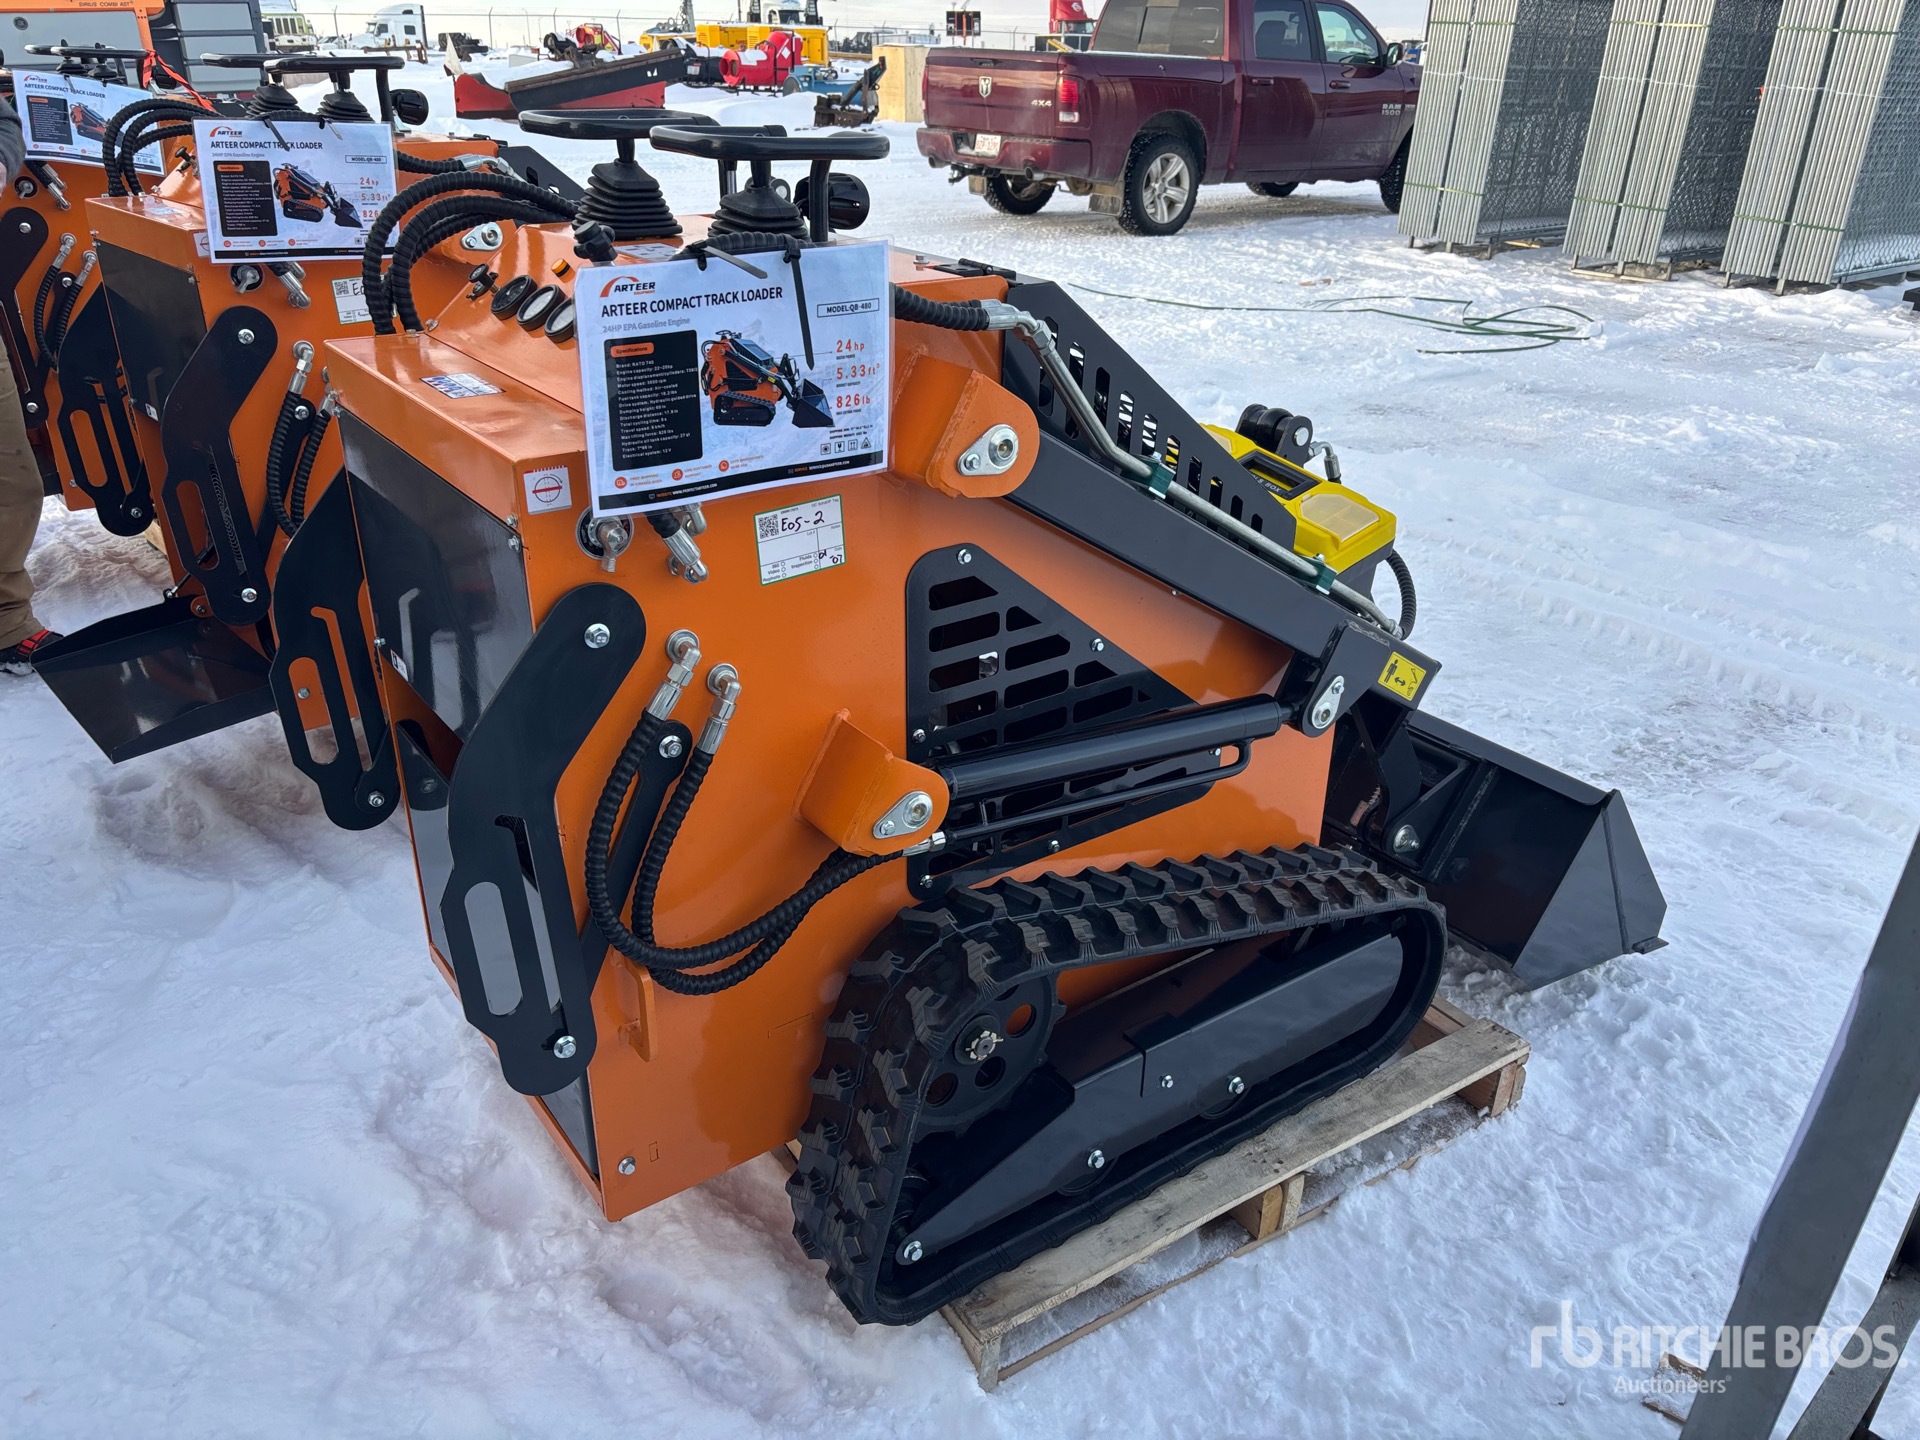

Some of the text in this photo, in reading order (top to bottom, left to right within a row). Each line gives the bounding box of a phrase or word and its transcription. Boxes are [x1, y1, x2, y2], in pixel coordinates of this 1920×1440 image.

[614, 282, 656, 293] ARTEER
[601, 286, 783, 318] ARTEER COMPACT TRACK LOADER
[602, 317, 691, 333] 24HP EPA Gasoline Engine
[616, 346, 648, 354] Specifications
[1265, 482, 1282, 492] BOX
[791, 560, 812, 569] Inspection
